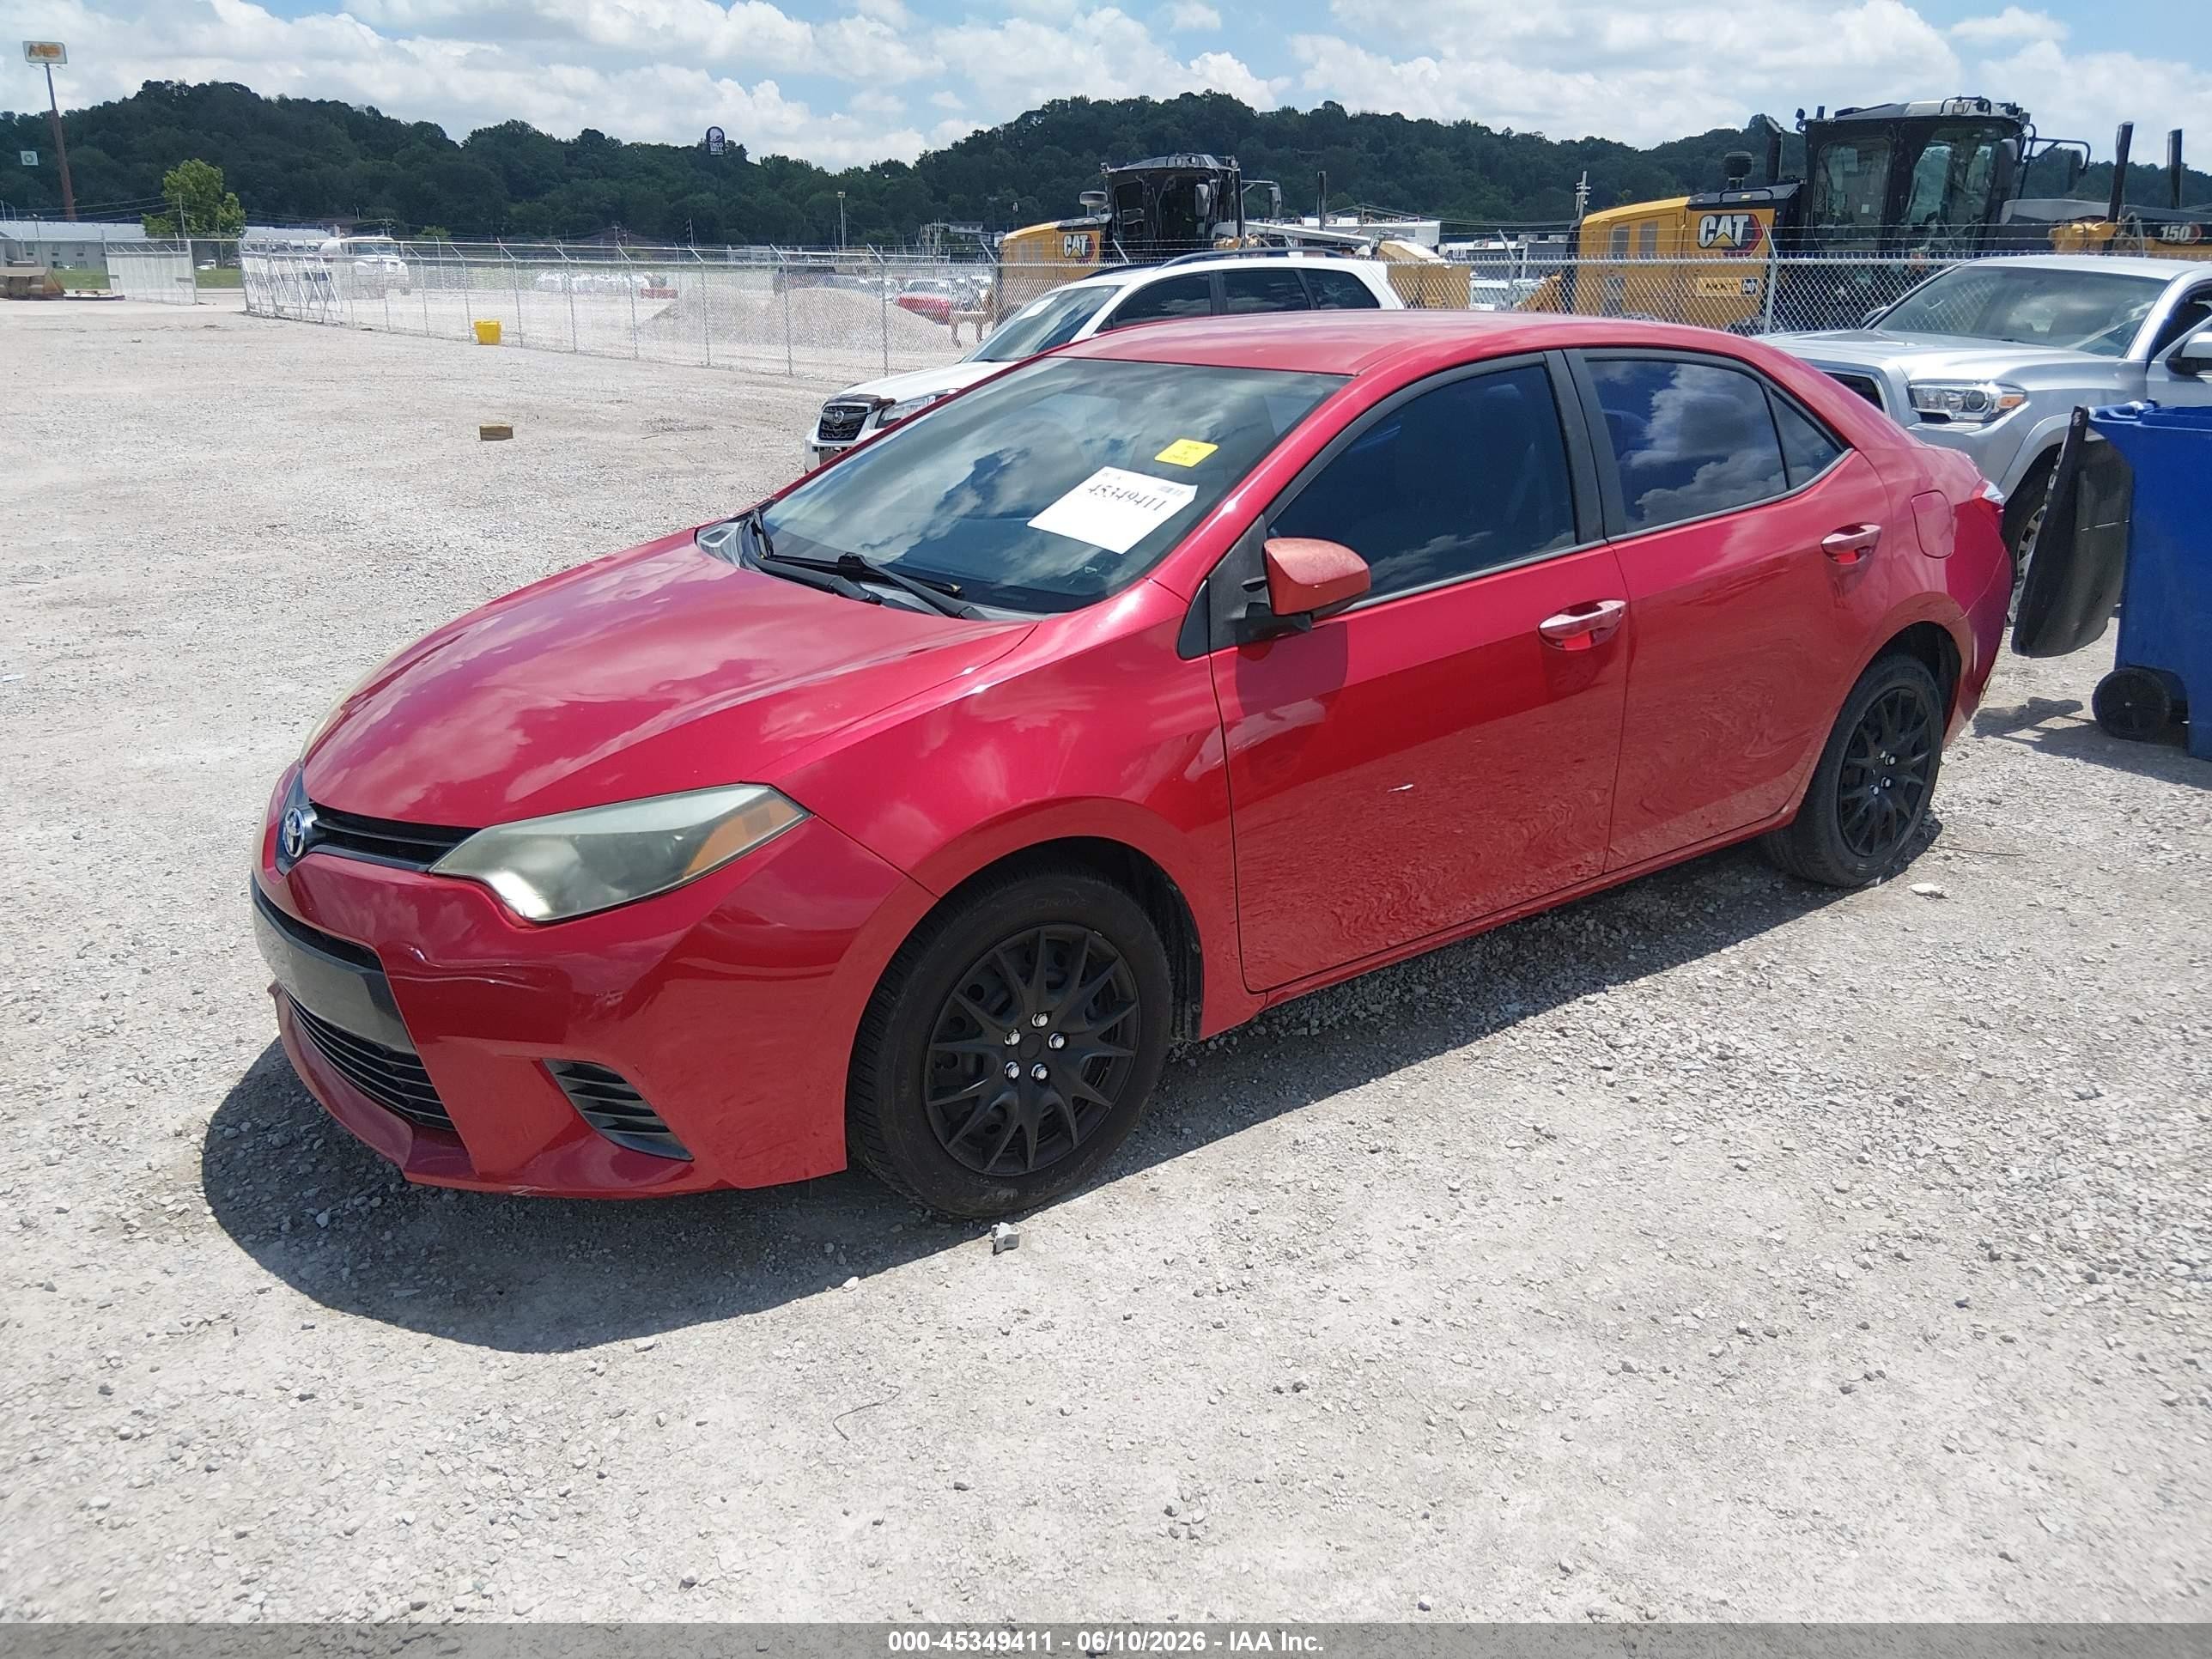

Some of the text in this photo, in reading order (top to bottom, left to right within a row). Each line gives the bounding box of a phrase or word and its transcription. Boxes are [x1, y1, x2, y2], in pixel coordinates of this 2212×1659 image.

[1699, 215, 1749, 247] CAT
[2160, 225, 2191, 241] 150
[1063, 234, 1088, 258] CAT
[1088, 483, 1168, 511] 45349411
